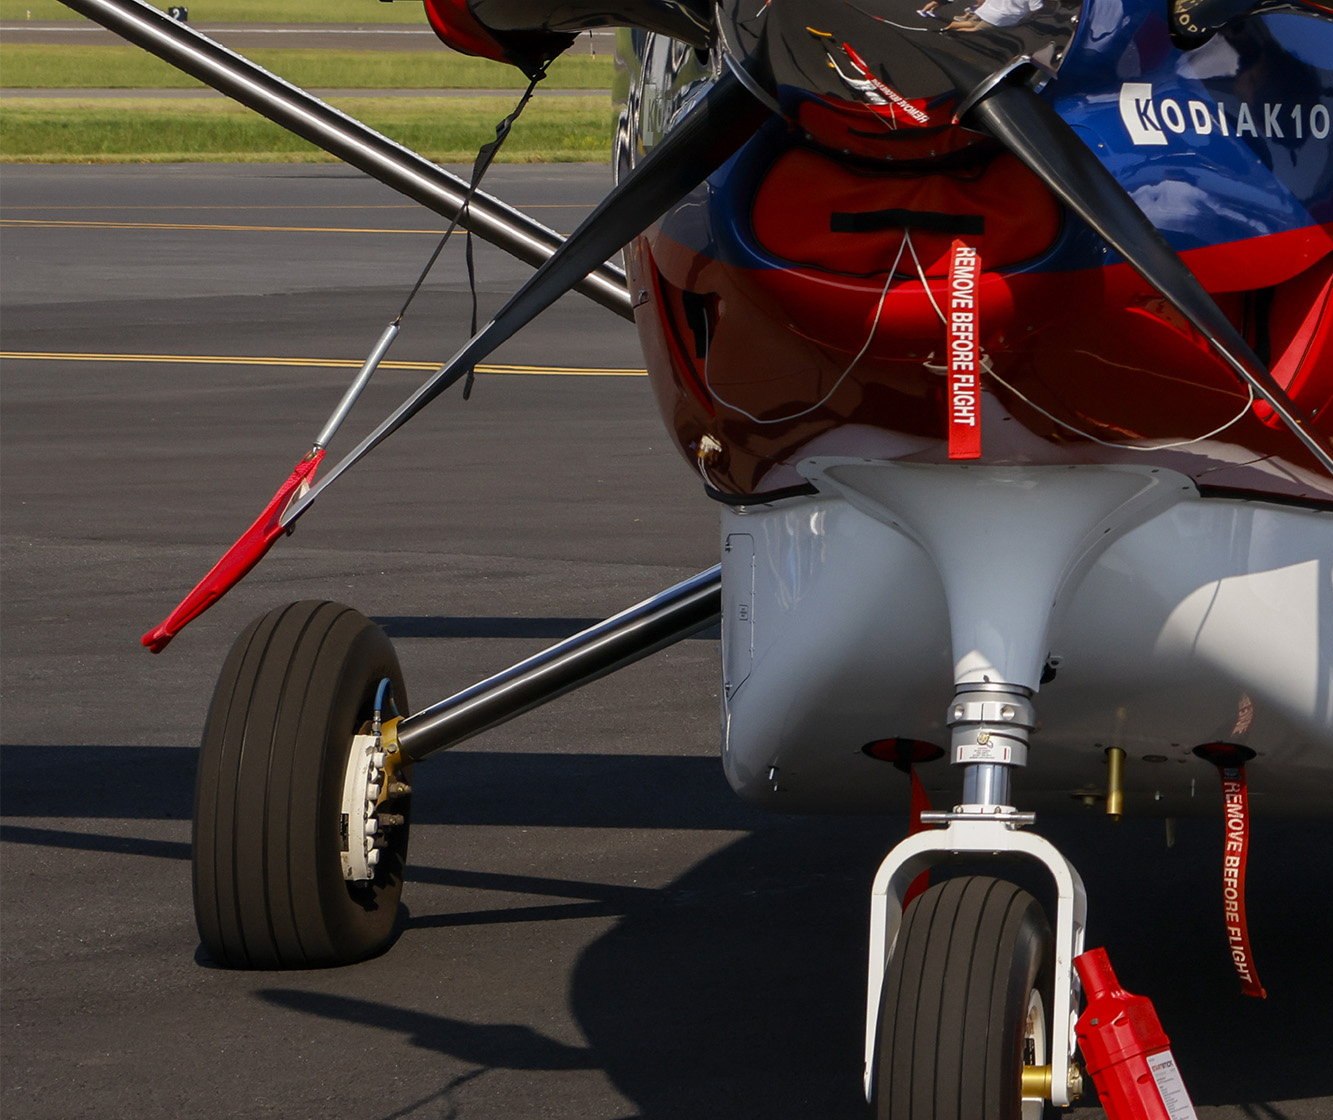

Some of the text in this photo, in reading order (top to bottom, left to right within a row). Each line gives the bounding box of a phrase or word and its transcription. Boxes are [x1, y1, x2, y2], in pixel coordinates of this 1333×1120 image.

[951, 247, 976, 426] REMOVE BEFORE FLIGHT
[1223, 782, 1252, 983] REMOVE BEFORE FLIGHT
